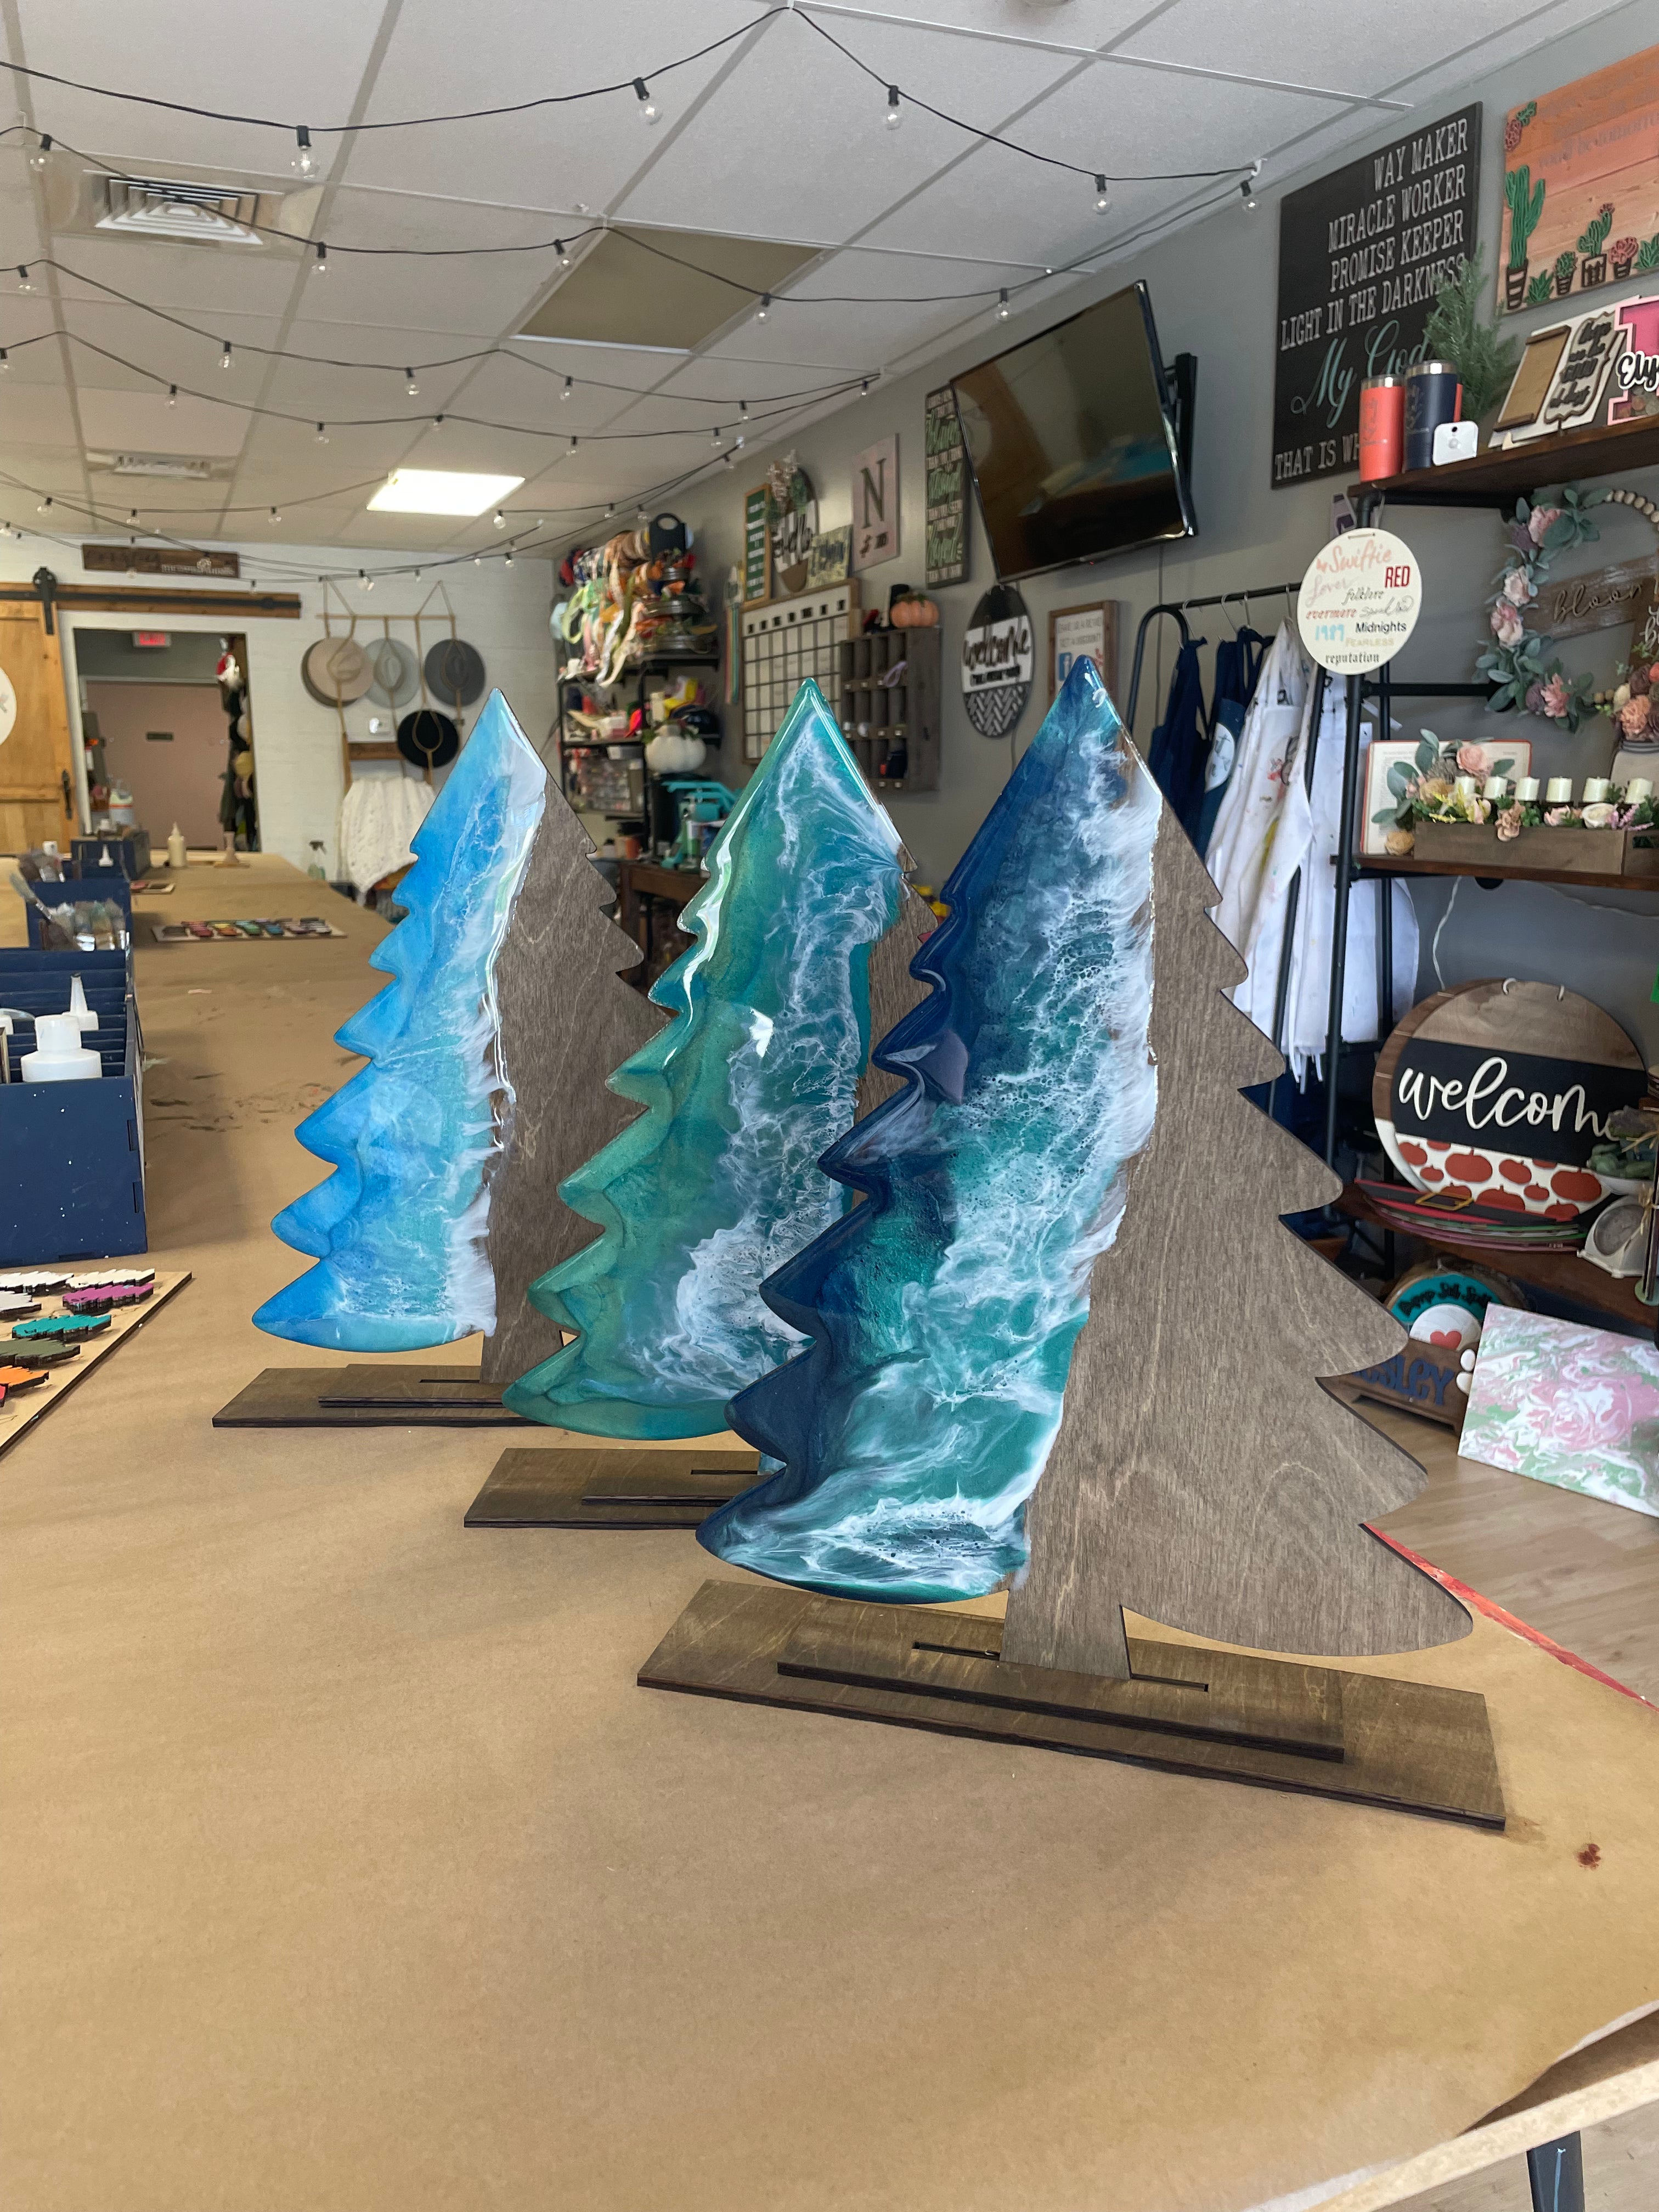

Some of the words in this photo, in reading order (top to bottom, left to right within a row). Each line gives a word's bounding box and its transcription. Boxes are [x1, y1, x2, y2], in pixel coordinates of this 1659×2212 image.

[1374, 146, 1406, 192] WAY
[1412, 118, 1468, 174] MAKER
[1328, 194, 1396, 253] MIRACLE
[1402, 164, 1466, 222] WORKER
[1330, 236, 1395, 293] PROMISE
[1400, 209, 1464, 265] KEEPER
[1280, 307, 1322, 351] LIGHT
[1326, 298, 1344, 334] IN
[1348, 286, 1376, 326] THE
[1290, 337, 1357, 429] My
[1275, 445, 1313, 481] THAT
[1317, 439, 1336, 469] IS
[1385, 566, 1410, 588] RED
[1306, 608, 1357, 620] evermore
[1315, 623, 1344, 641] 1989
[1355, 622, 1407, 634] Midnights
[1325, 652, 1379, 666] reputation
[1345, 637, 1395, 647] FEARLESS
